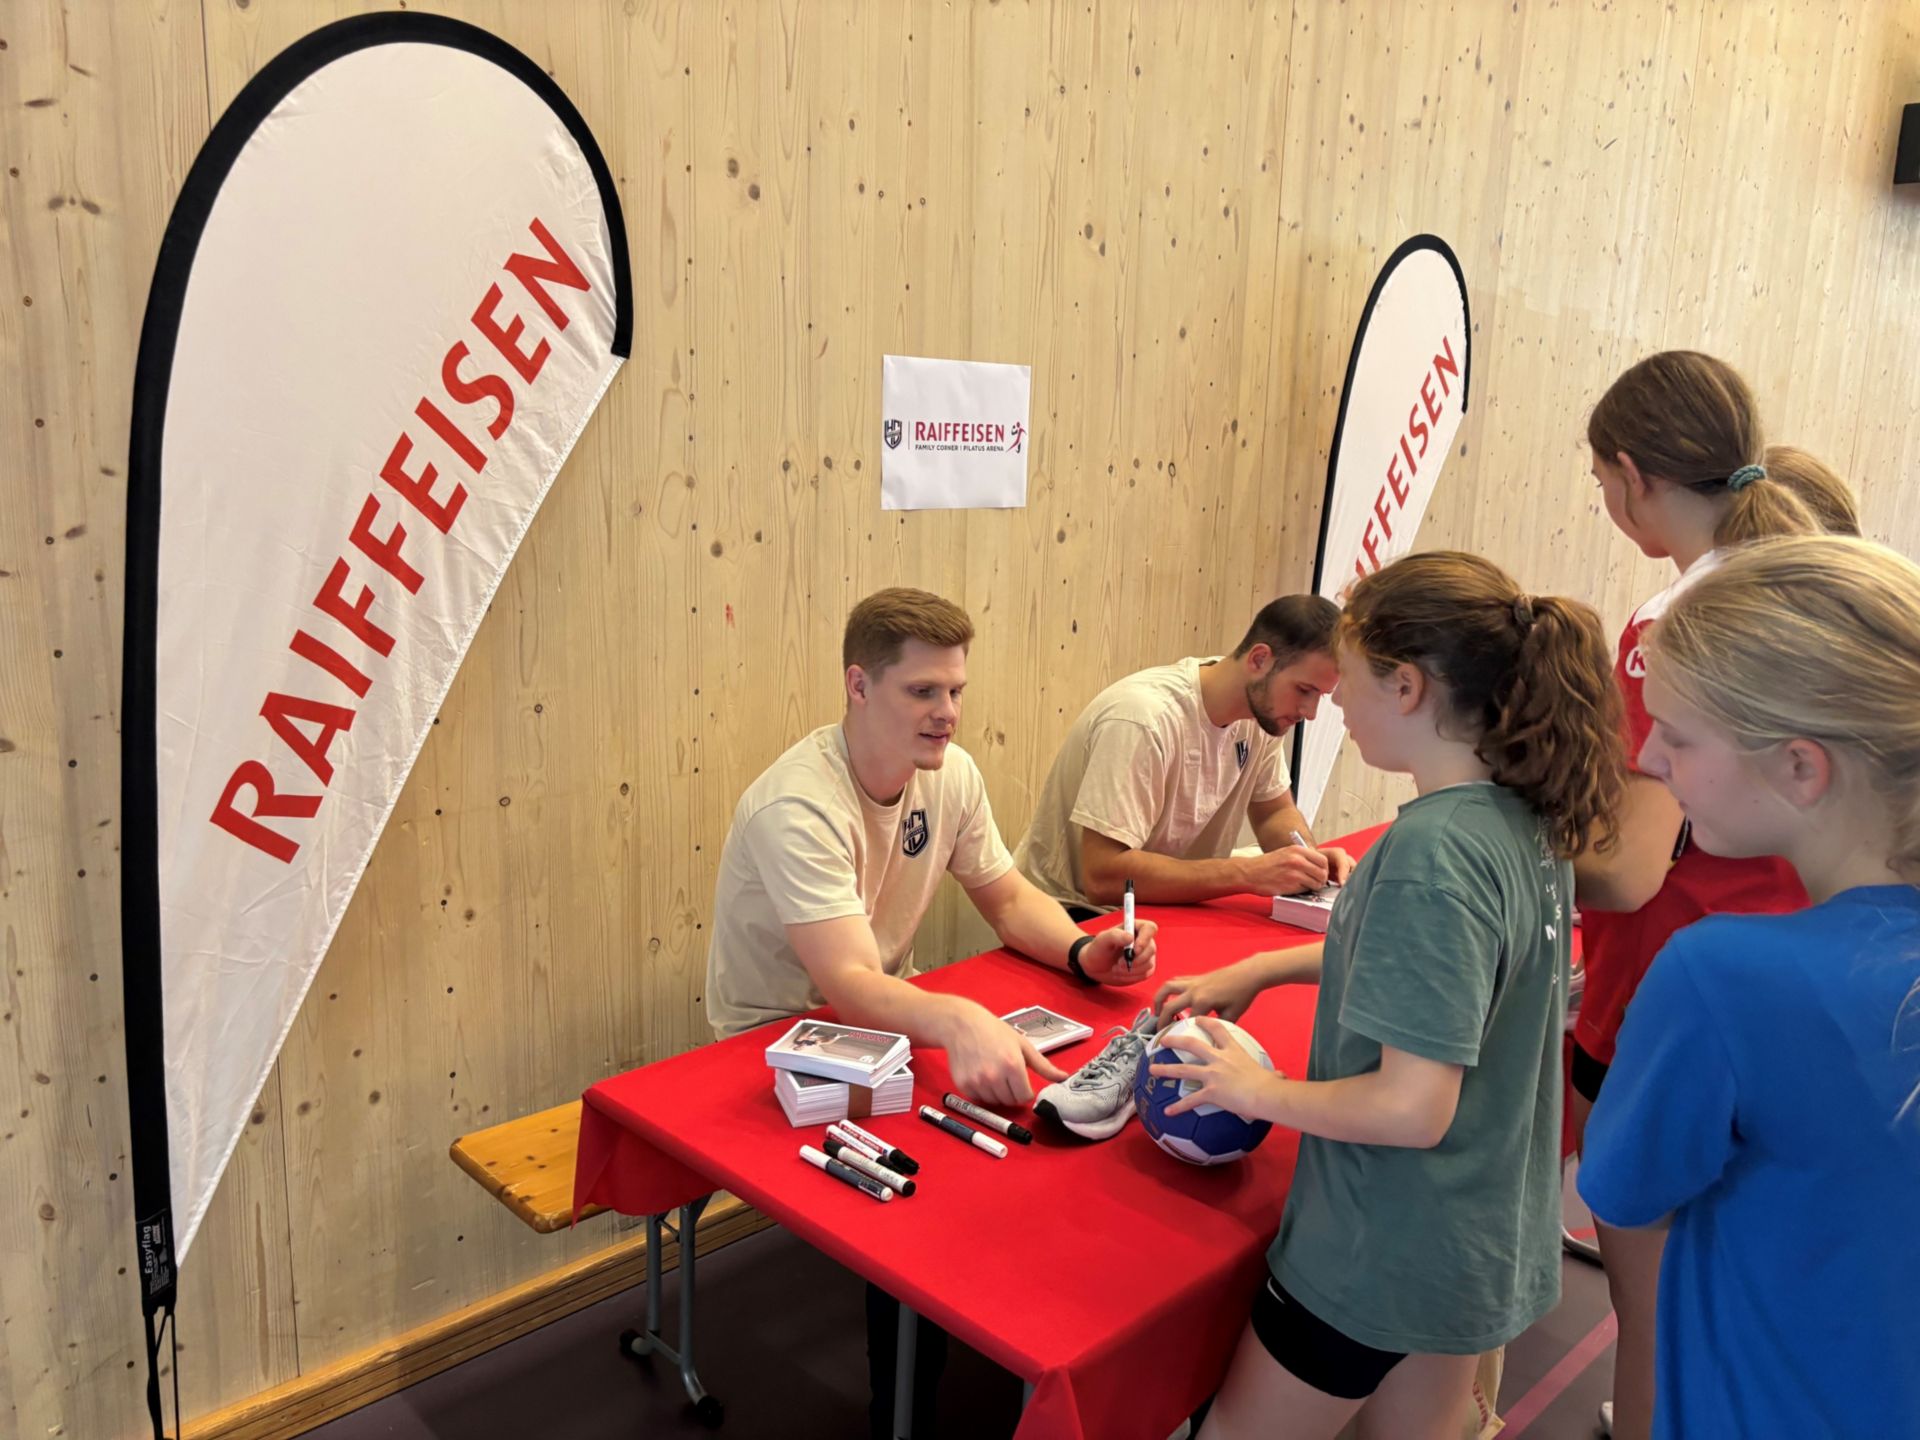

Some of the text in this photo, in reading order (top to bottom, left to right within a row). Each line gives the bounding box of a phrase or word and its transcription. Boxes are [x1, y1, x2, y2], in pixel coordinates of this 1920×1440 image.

[915, 421, 1005, 443] RAIFFEISEN
[1344, 336, 1460, 600] IFFEISEN
[209, 216, 592, 865] RAIFFEISEN
[142, 1225, 154, 1274] Easyflag
